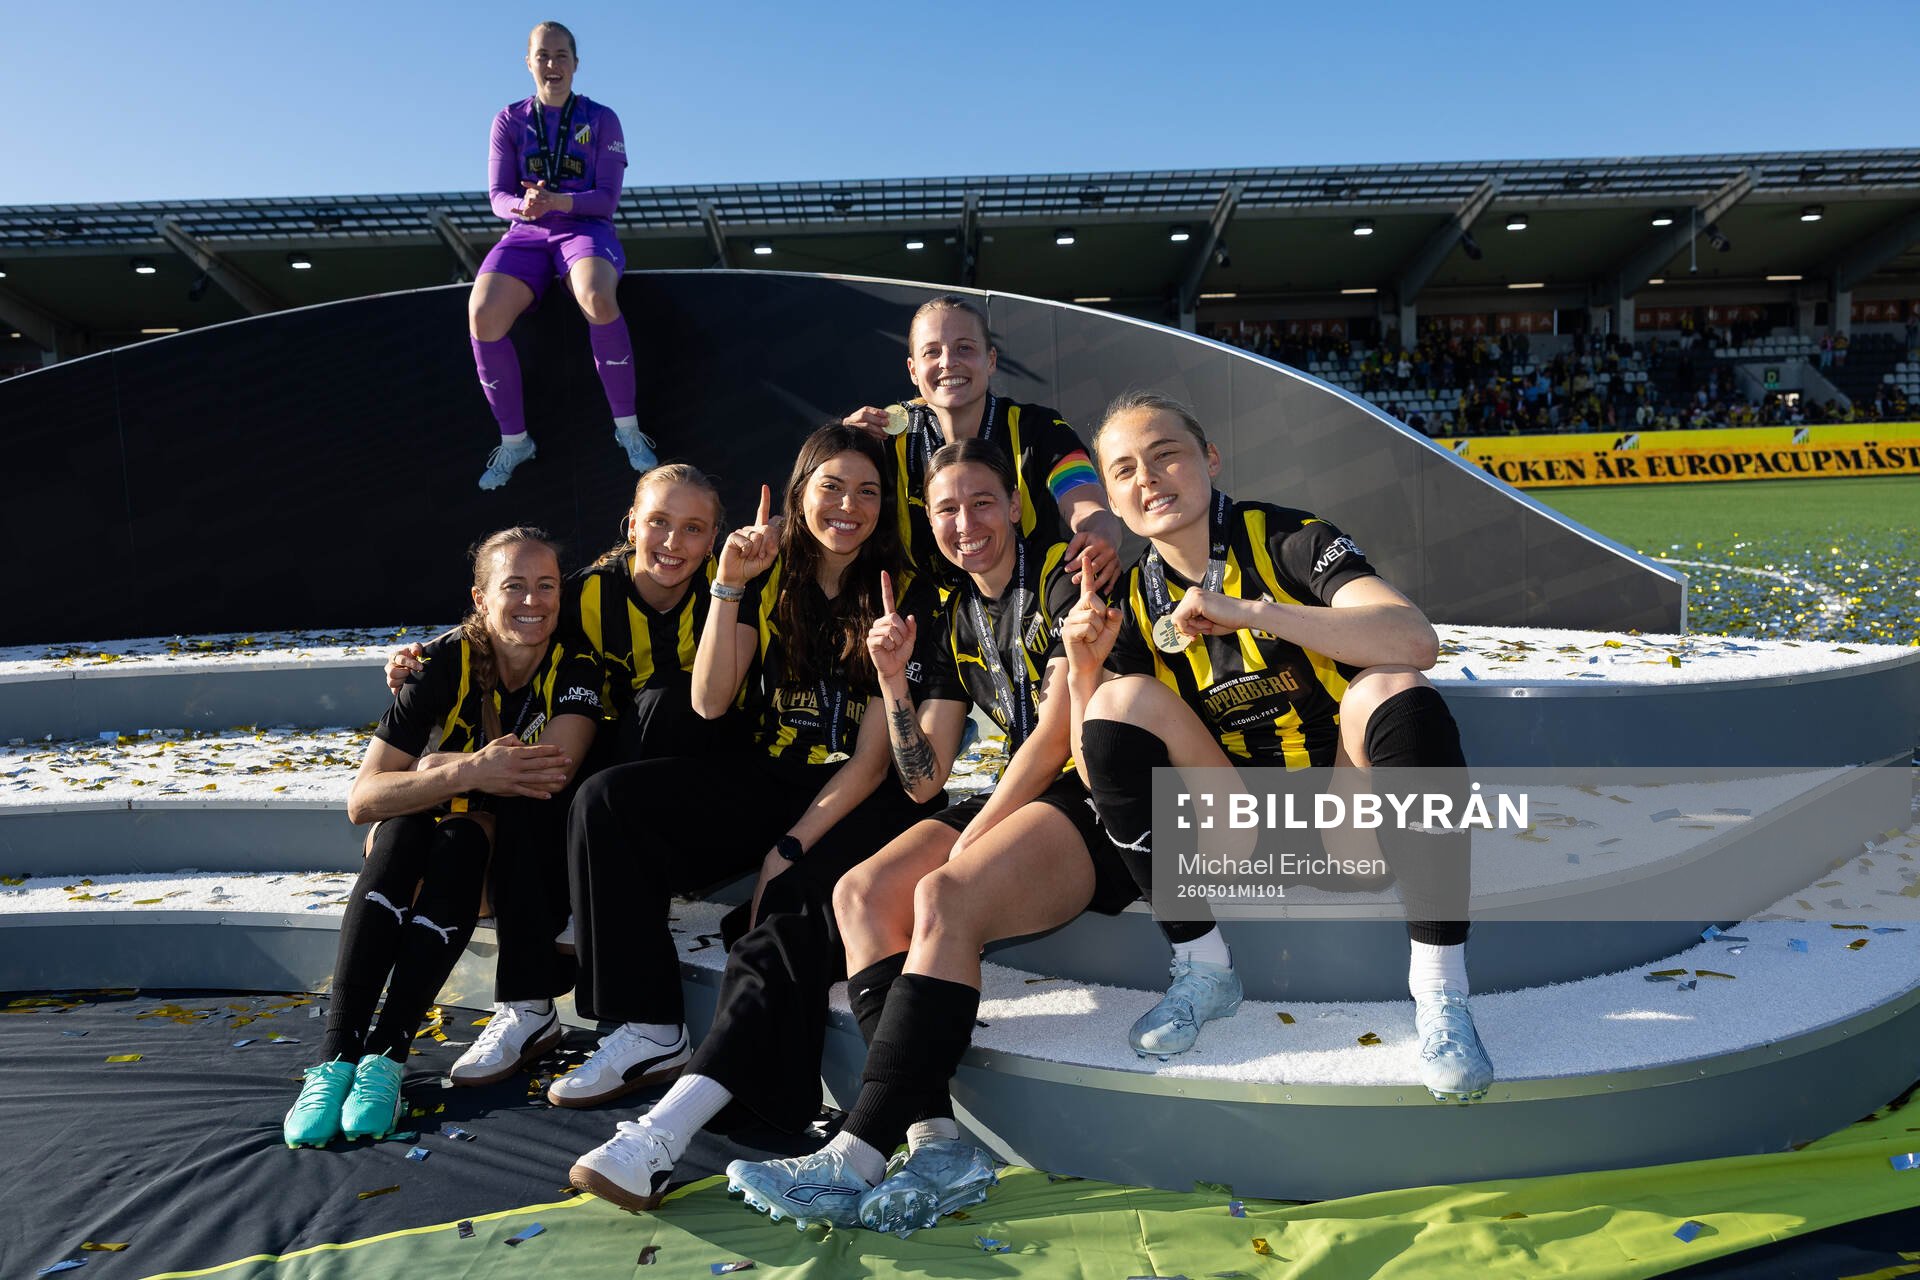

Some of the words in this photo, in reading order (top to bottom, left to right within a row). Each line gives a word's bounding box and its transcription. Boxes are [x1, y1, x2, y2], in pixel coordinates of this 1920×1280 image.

[1473, 455, 1586, 482] ÄCKEN
[1593, 451, 1640, 479] ÄR
[1203, 670, 1299, 717] OPPARBERG
[1208, 678, 1239, 695] PREMIUM
[1238, 674, 1260, 683] CIDER
[1230, 706, 1279, 727] ALCOHOL-FREE
